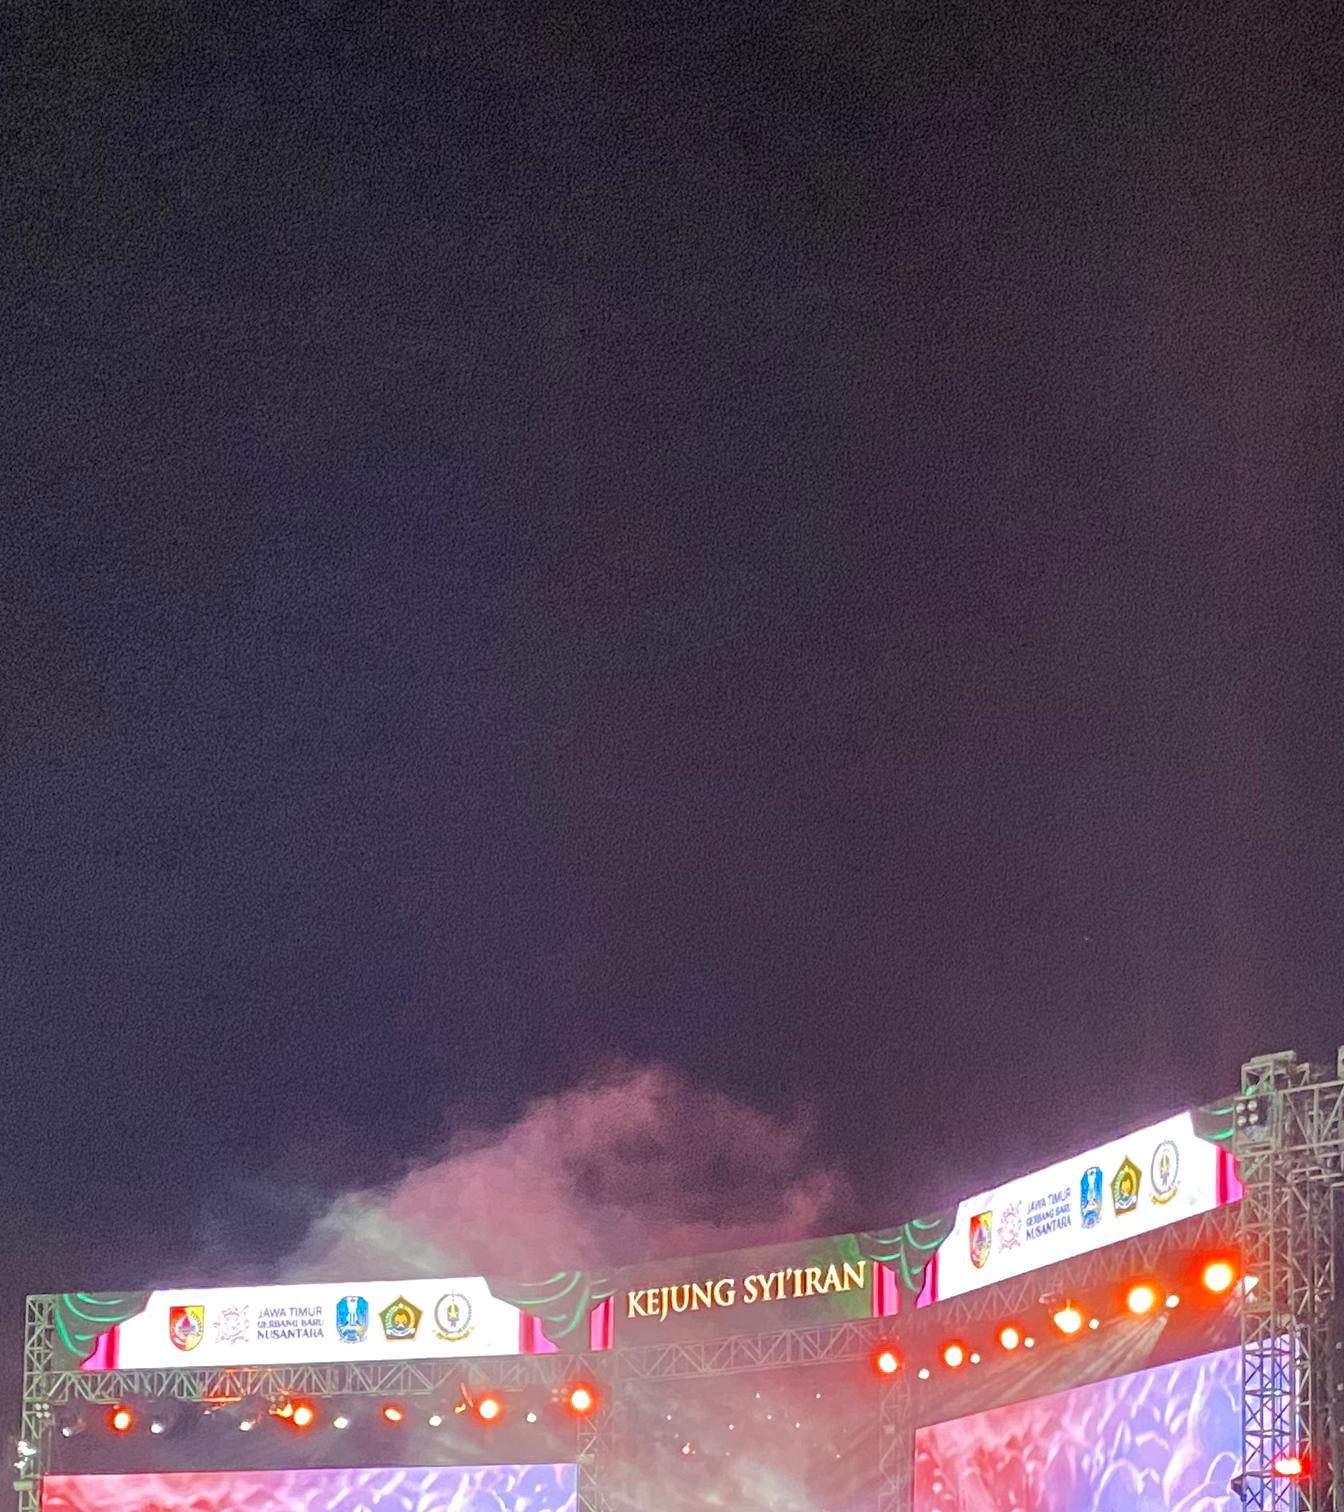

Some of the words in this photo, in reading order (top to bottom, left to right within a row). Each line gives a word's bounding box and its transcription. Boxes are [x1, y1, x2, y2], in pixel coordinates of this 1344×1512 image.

[627, 1278, 735, 1322] KEJUNG
[744, 1260, 866, 1304] SYI'IRAN
[258, 1307, 286, 1319] JAWA
[288, 1306, 322, 1316] TIMUR
[257, 1328, 324, 1339] NUSANTARA
